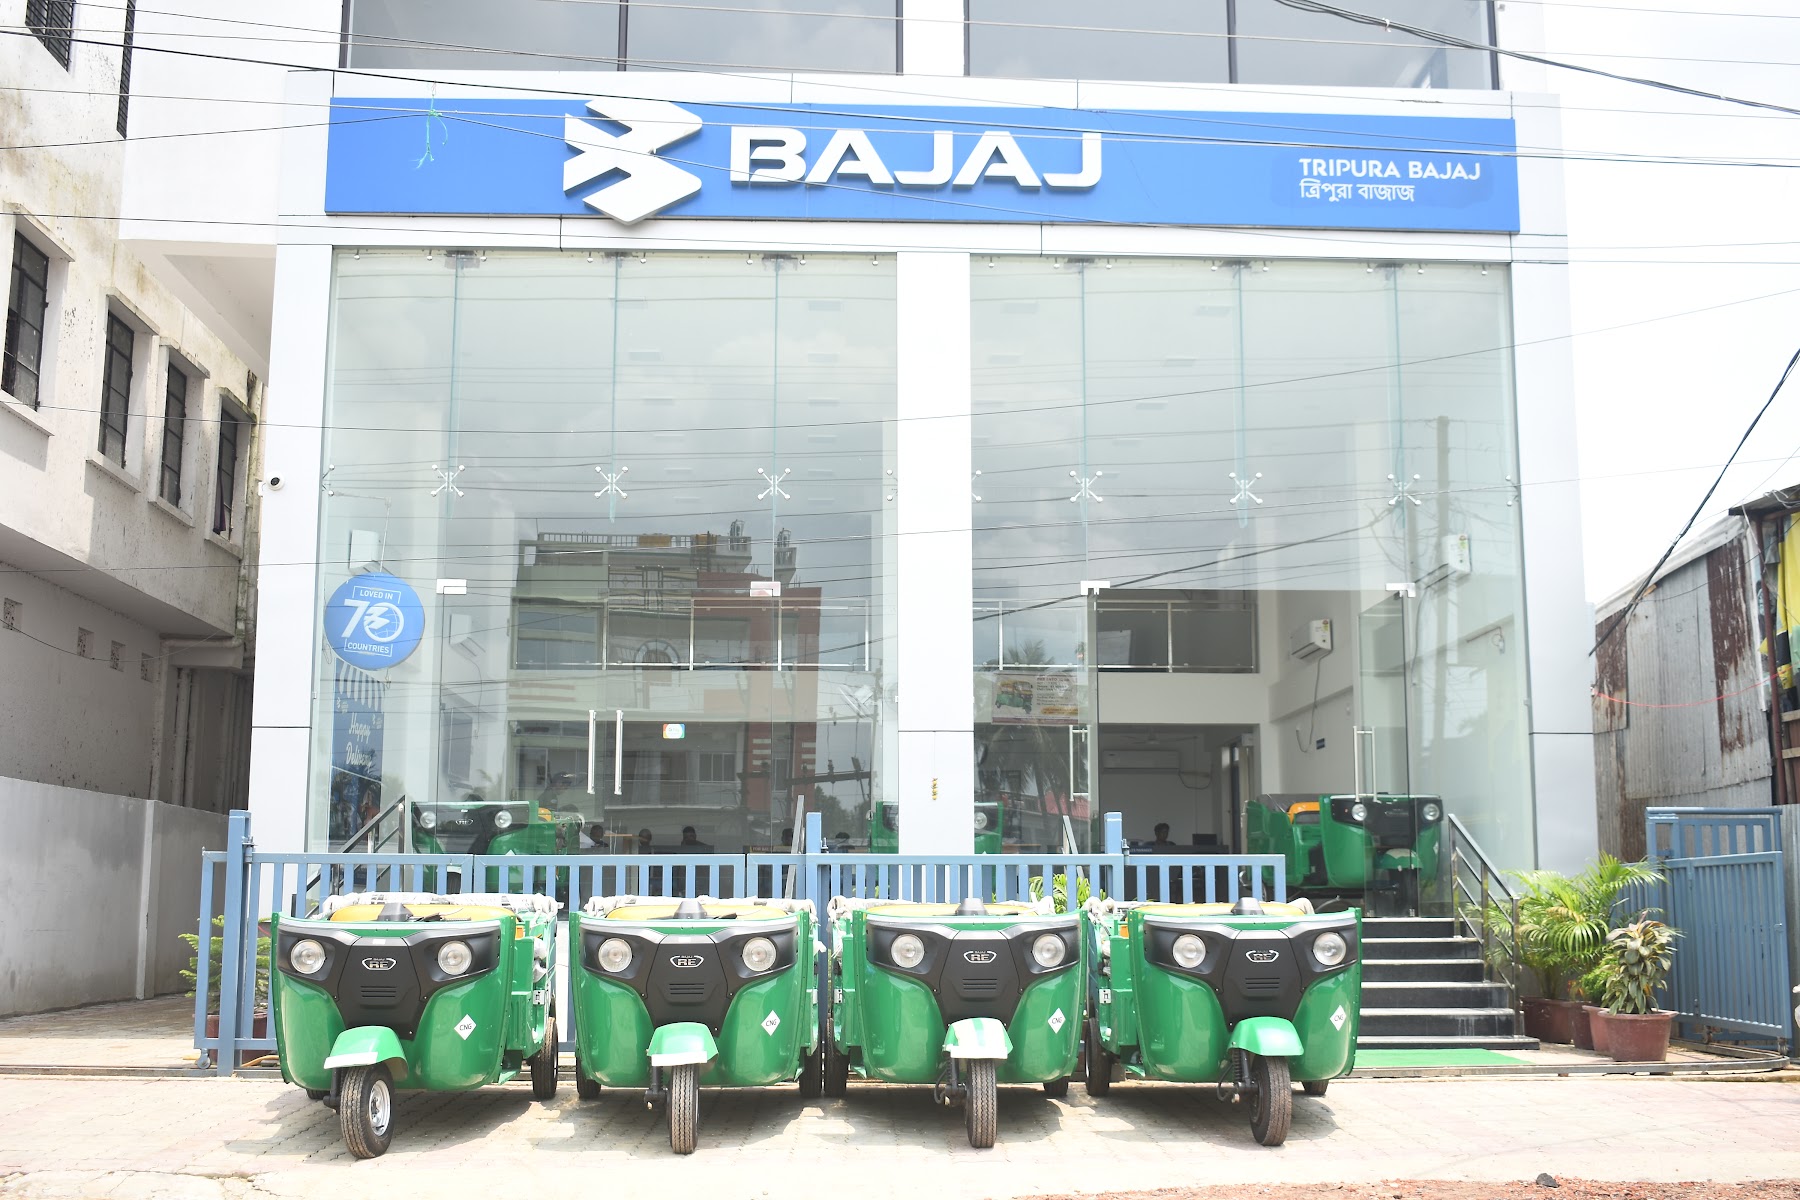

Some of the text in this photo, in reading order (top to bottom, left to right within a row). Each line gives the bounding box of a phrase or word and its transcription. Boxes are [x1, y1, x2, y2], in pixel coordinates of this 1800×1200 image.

[730, 126, 1102, 188] BAJAJ
[1299, 158, 1481, 180] TRIPURA BAJAJ
[1299, 178, 1415, 202] ত্রিপুরা বাজাজ
[360, 589, 394, 600] LOVED IN
[347, 642, 390, 654] COUNTRIES
[369, 961, 389, 969] RE
[677, 958, 697, 966] RE
[459, 1023, 472, 1031] CNG
[765, 1019, 777, 1027] CNG
